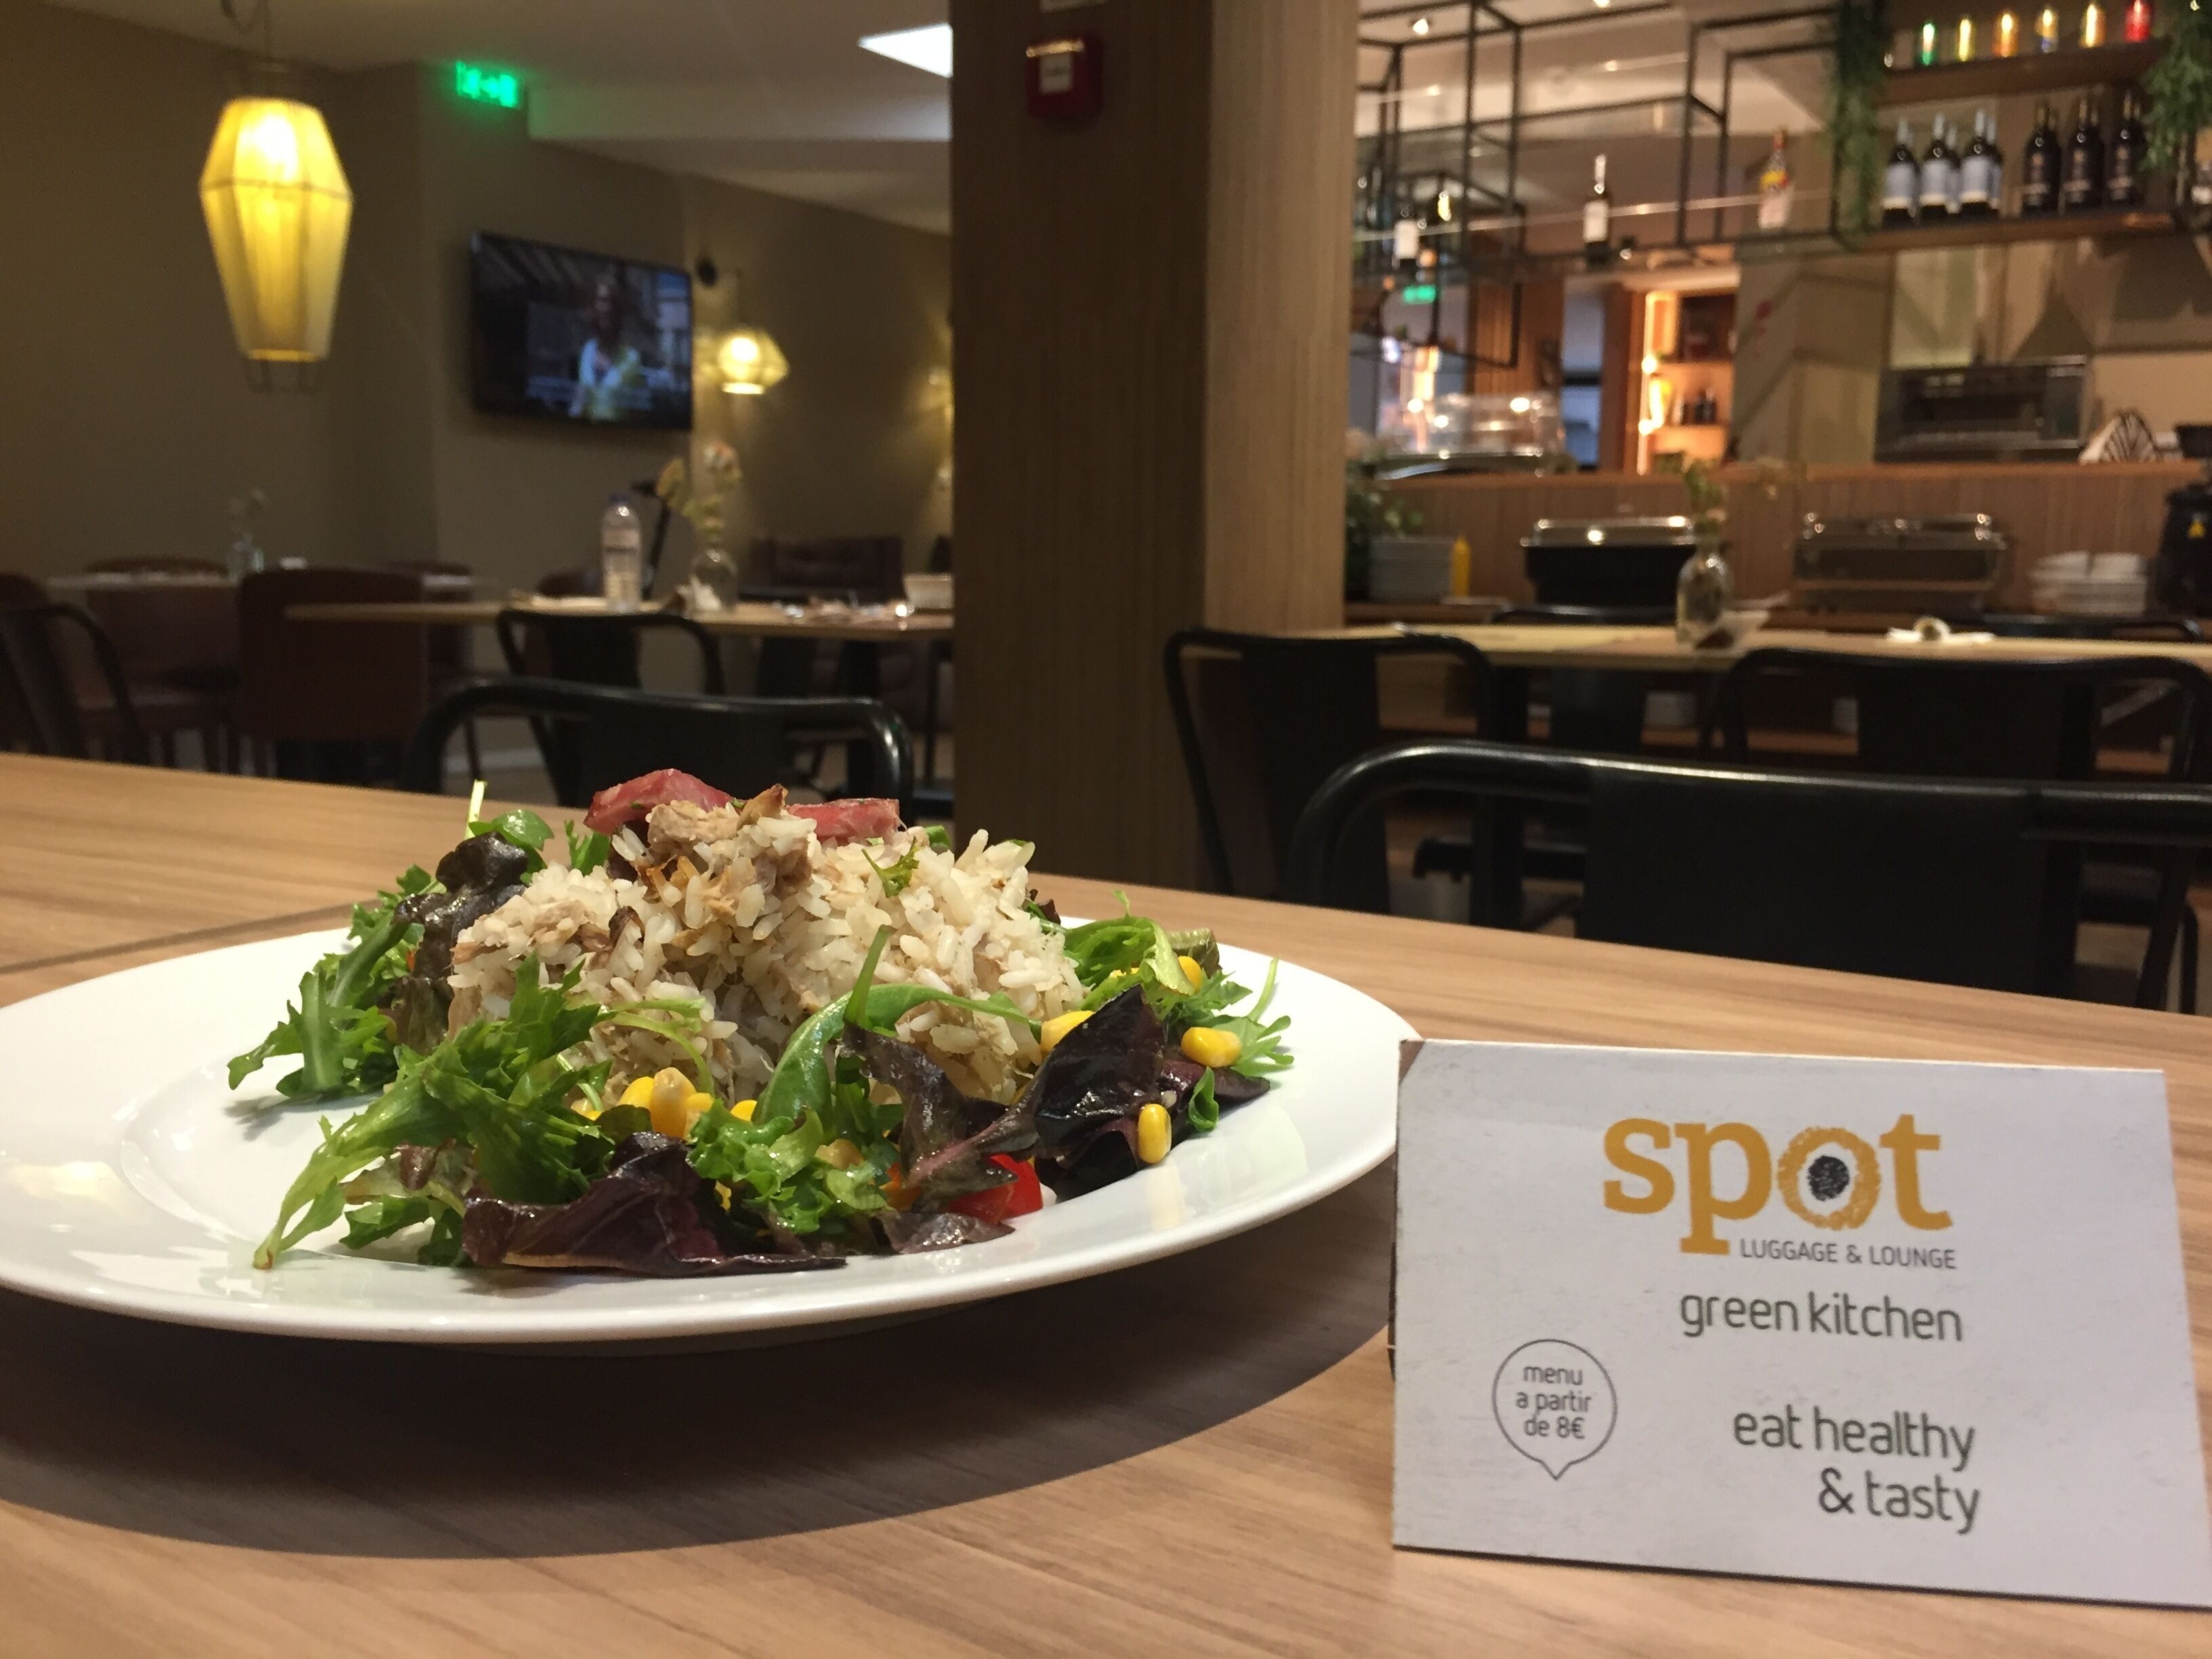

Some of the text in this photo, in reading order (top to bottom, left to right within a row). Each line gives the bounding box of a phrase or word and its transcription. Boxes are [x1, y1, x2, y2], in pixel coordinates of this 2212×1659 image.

[1603, 1113, 1953, 1254] spot
[1740, 1239, 1957, 1270] LUGGAGE & LOUNGE
[1679, 1291, 1963, 1342] green kitchen
[1523, 1366, 1583, 1386] menu
[1515, 1390, 1592, 1415] a partir
[1523, 1412, 1585, 1439] de 8€
[1734, 1404, 1975, 1473] eat healthy
[1818, 1466, 1980, 1536] & tasty
